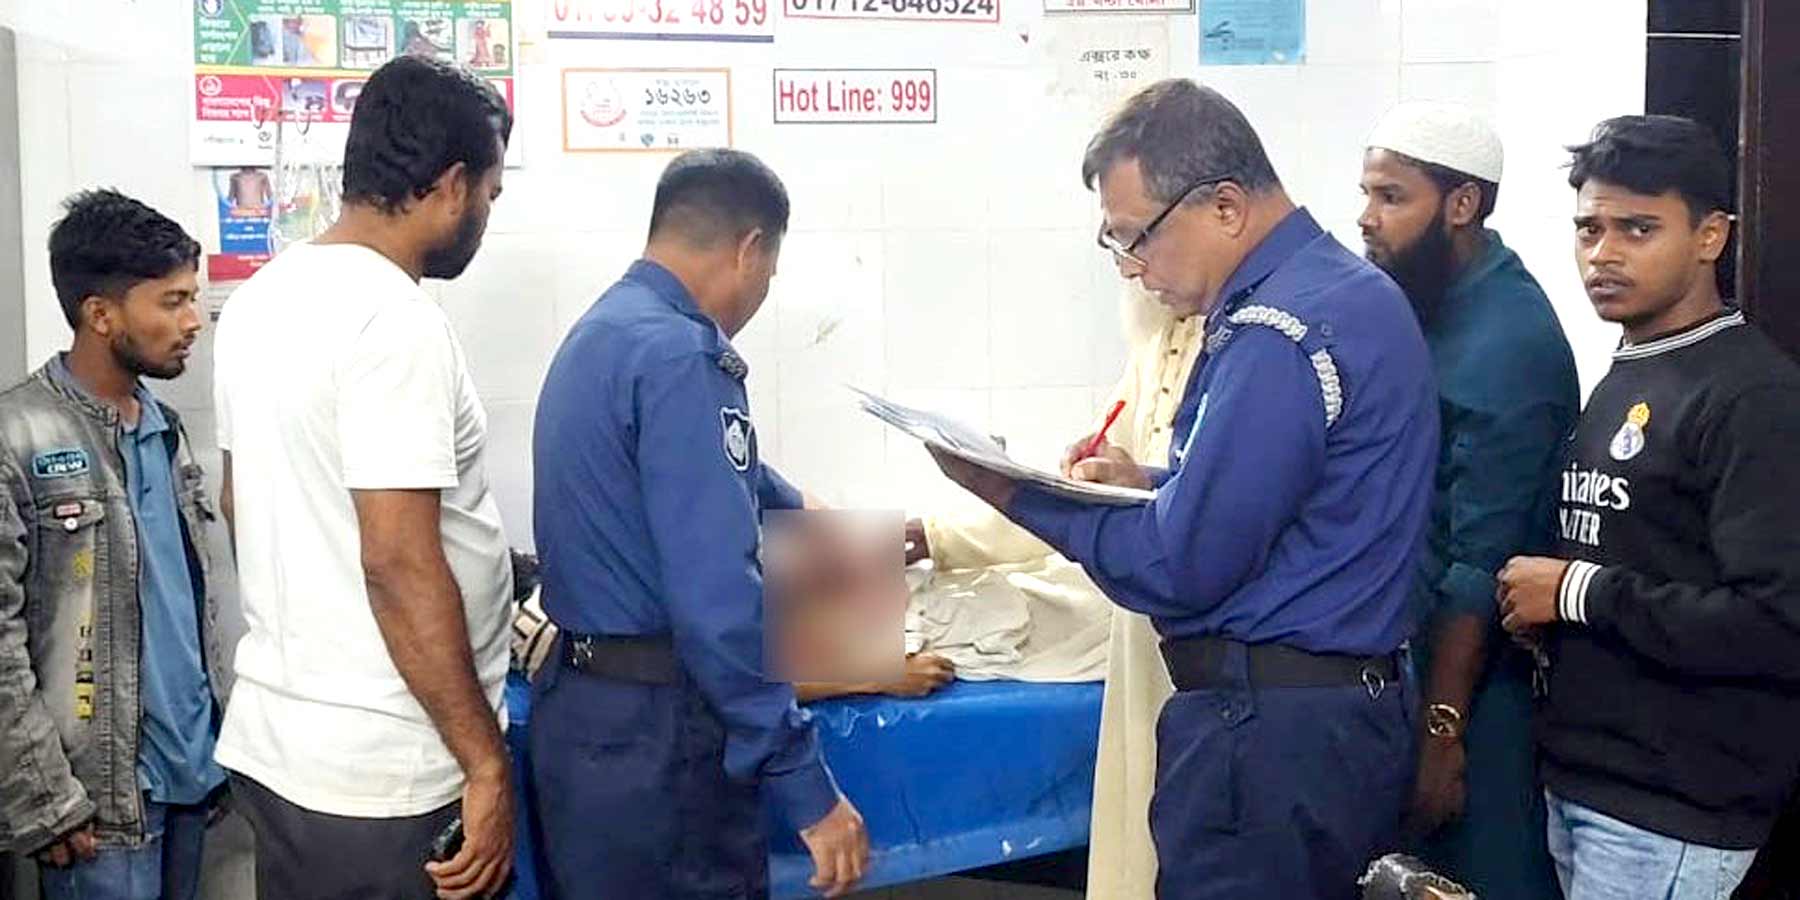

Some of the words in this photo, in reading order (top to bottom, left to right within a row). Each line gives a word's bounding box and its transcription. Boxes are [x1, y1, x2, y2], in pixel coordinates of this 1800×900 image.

[736, 0, 768, 26] 59
[645, 87, 711, 107] ১৬২৬৩
[779, 79, 819, 112] Hot
[827, 79, 882, 112] Line:
[891, 79, 931, 112] 999
